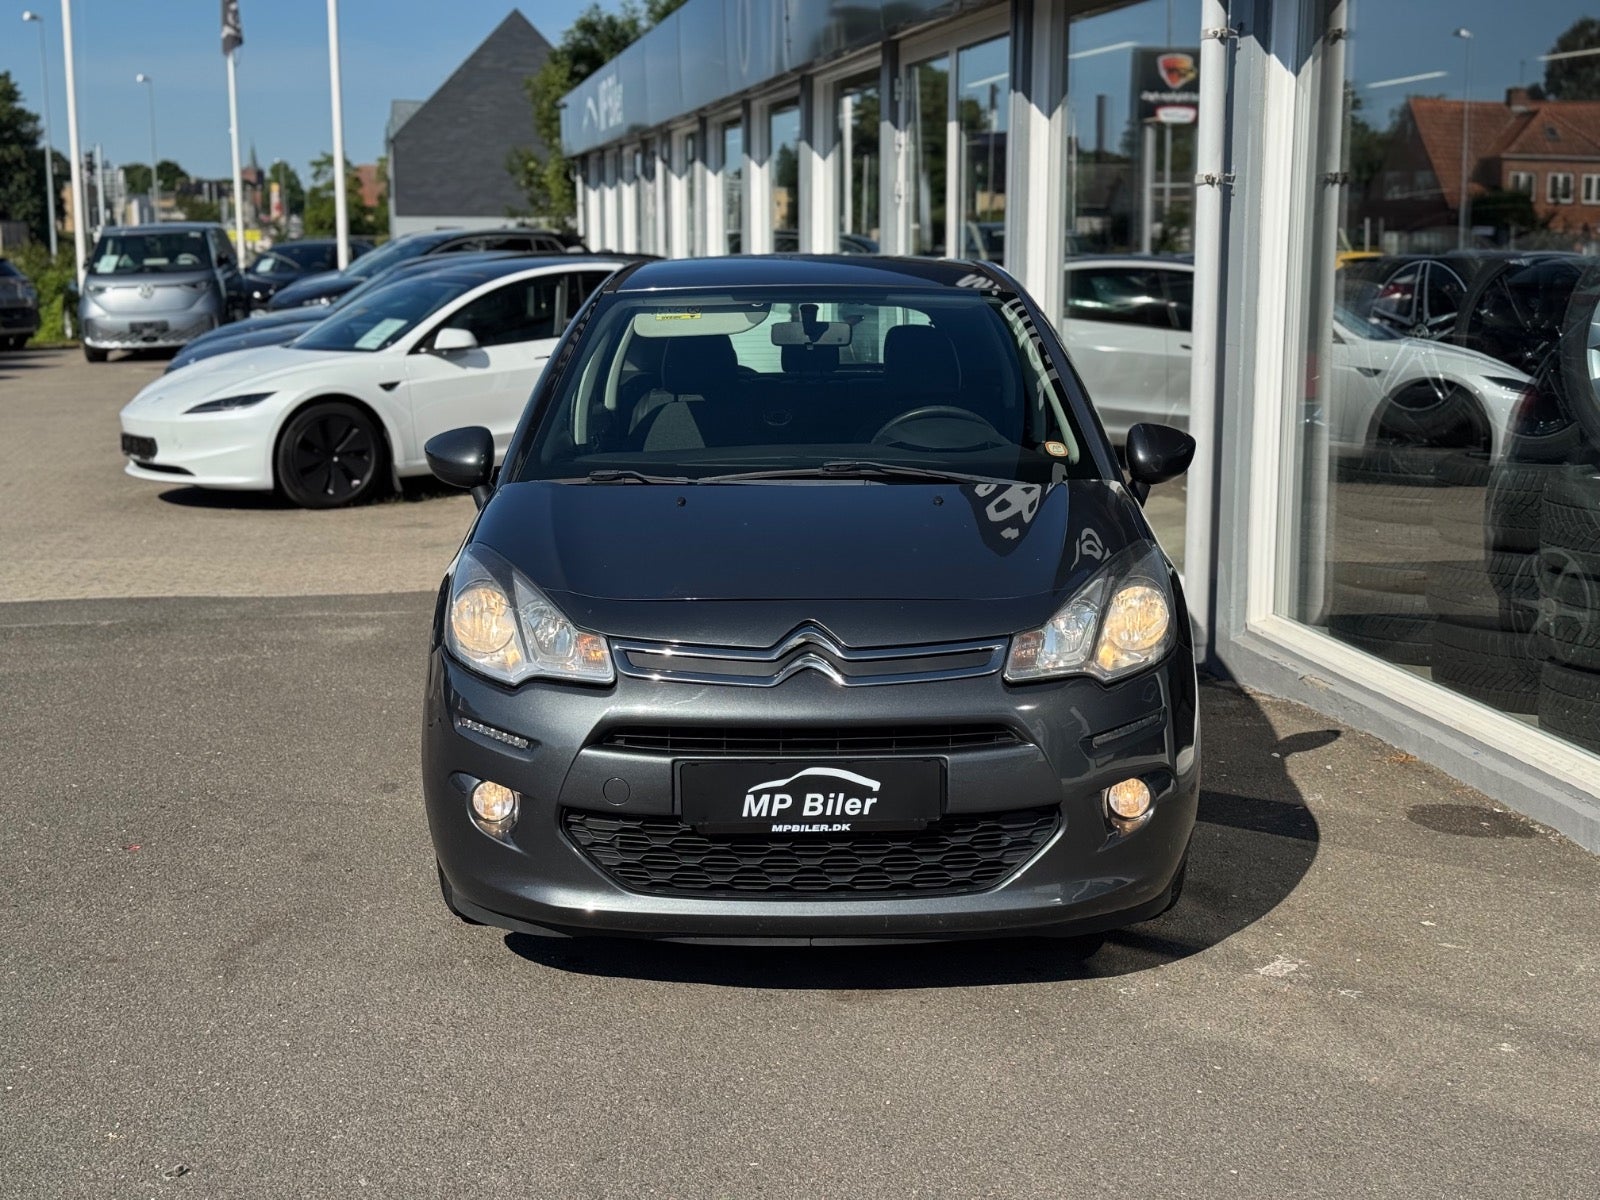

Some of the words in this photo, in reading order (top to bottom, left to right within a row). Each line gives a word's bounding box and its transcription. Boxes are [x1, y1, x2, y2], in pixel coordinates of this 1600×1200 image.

[742, 794, 793, 817] MP
[802, 793, 877, 816] Biler
[771, 823, 851, 832] MPBILER.DK
